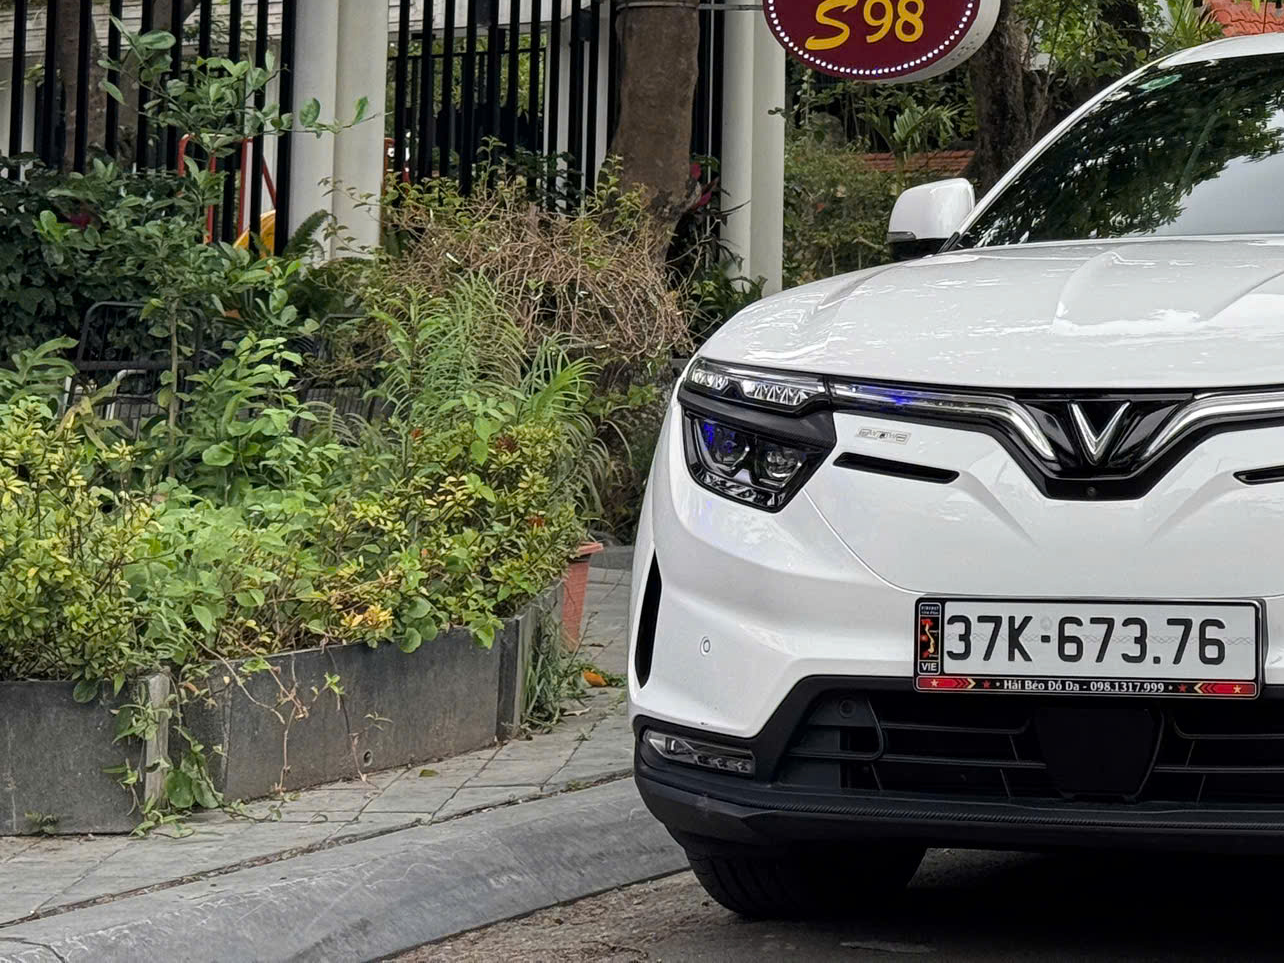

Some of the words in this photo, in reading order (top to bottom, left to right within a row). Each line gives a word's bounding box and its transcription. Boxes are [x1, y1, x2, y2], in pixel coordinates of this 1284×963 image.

[946, 615, 1226, 666] 37K-673.76
[921, 662, 937, 671] VIE
[1090, 681, 1164, 693] 098.1317.999
